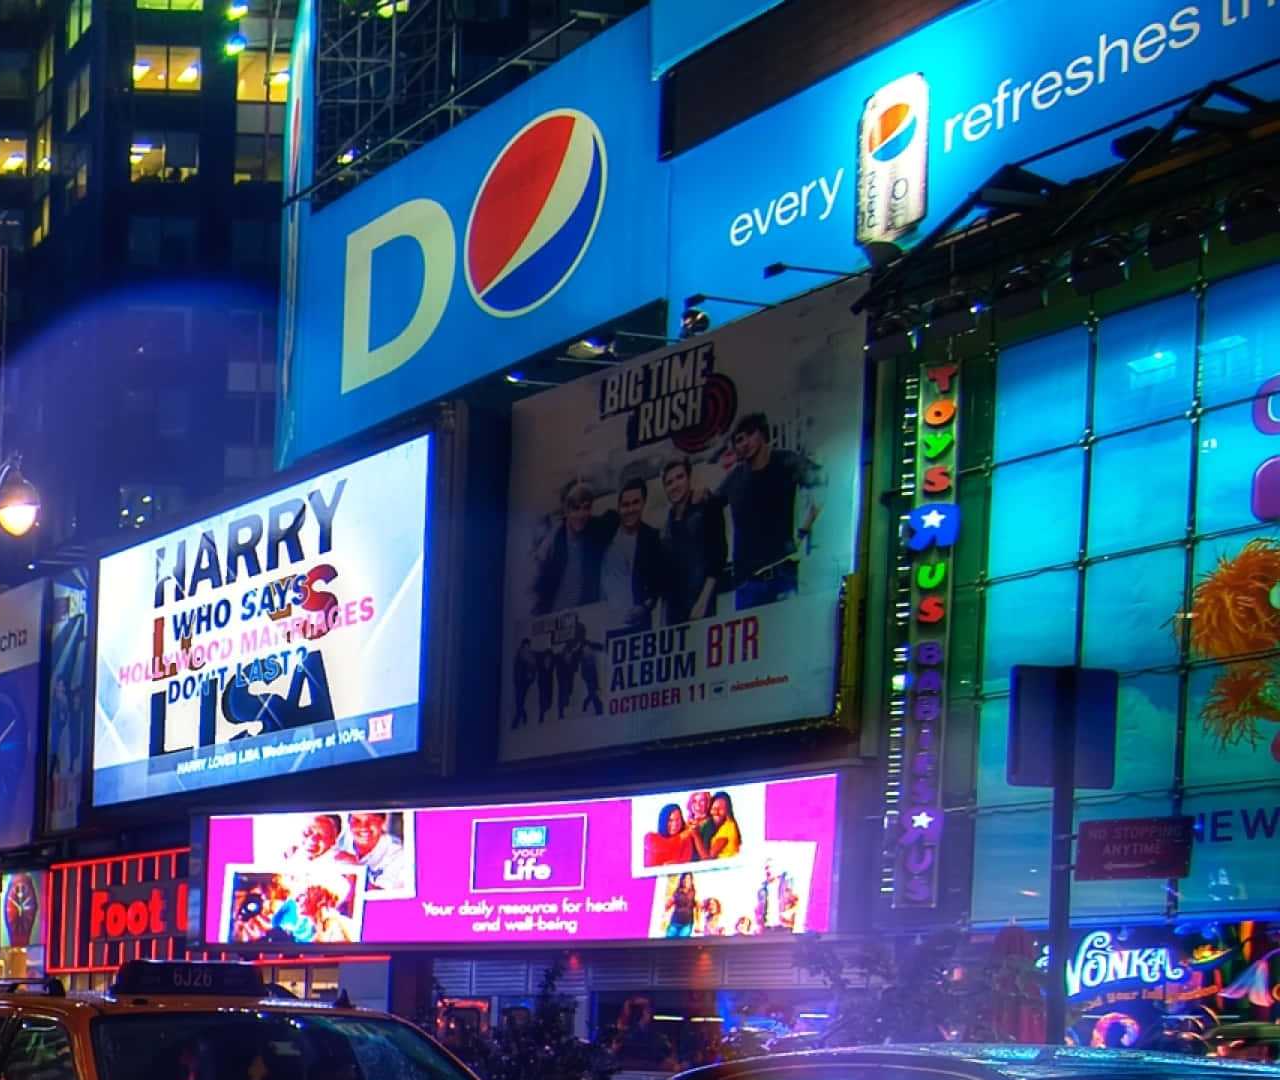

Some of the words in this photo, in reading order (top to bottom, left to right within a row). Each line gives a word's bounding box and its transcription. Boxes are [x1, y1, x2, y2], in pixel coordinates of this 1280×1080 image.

[944, 6, 1201, 154] refreshes
[729, 168, 844, 247] every
[604, 369, 644, 414] BIG
[649, 344, 713, 399] TIME
[638, 386, 705, 443] RUSH
[922, 363, 958, 493] TOYS
[154, 478, 348, 609] HARRY
[171, 598, 231, 642] WHO
[241, 573, 310, 621] SAYS
[118, 637, 234, 688] HOLLYWOOD
[240, 597, 375, 653] MARRIAGES
[611, 624, 692, 666] DEBUT
[706, 615, 760, 670] BTR
[168, 666, 228, 704] DON'T
[610, 651, 697, 693] ALBUM
[149, 649, 336, 758] LISA
[609, 687, 682, 717] OCTOBER
[687, 682, 707, 703] 11
[502, 857, 552, 881] Life
[1102, 842, 1162, 857] ANYTIME
[90, 888, 165, 939] Foot
[421, 901, 456, 917] Your
[458, 899, 495, 919] daily
[497, 901, 559, 915] resource
[561, 896, 583, 914] for
[585, 895, 629, 913] health
[472, 916, 501, 932] and
[503, 915, 579, 934] well-being
[172, 968, 213, 987] 6J26
